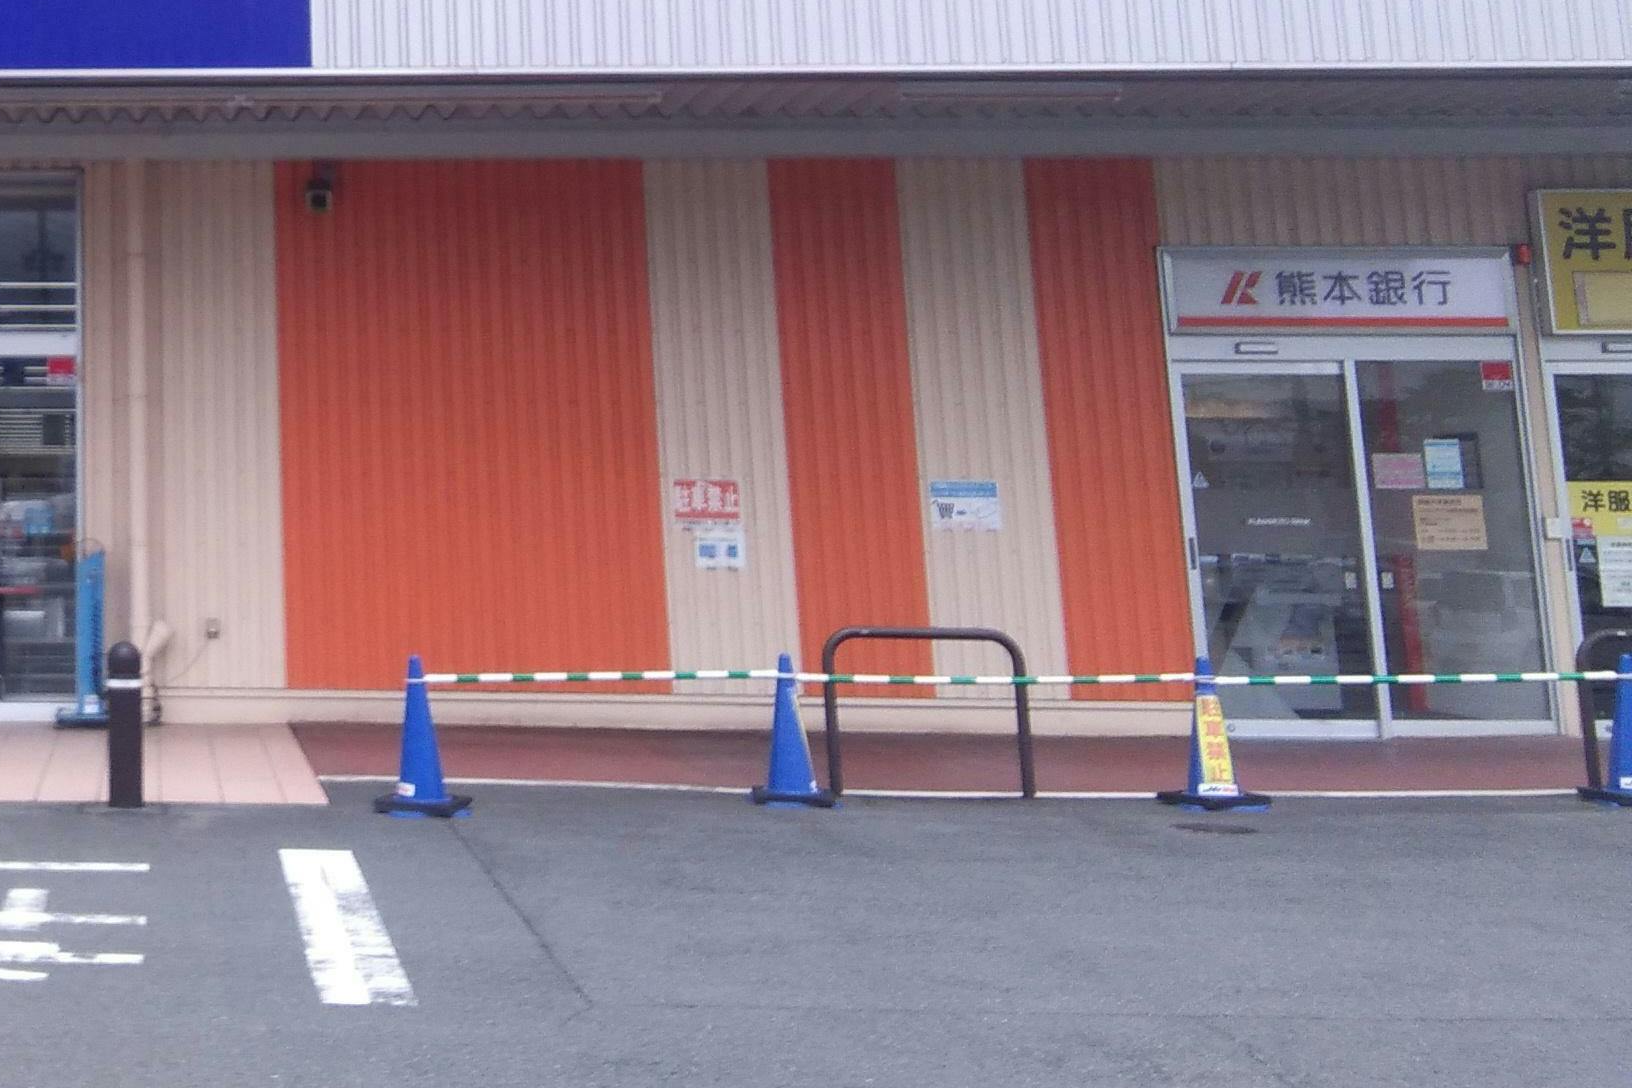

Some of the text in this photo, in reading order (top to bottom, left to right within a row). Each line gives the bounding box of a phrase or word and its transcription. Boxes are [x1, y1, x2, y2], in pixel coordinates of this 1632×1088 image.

[1558, 207, 1632, 260] 洋
[1275, 270, 1451, 306] 熊本銀行
